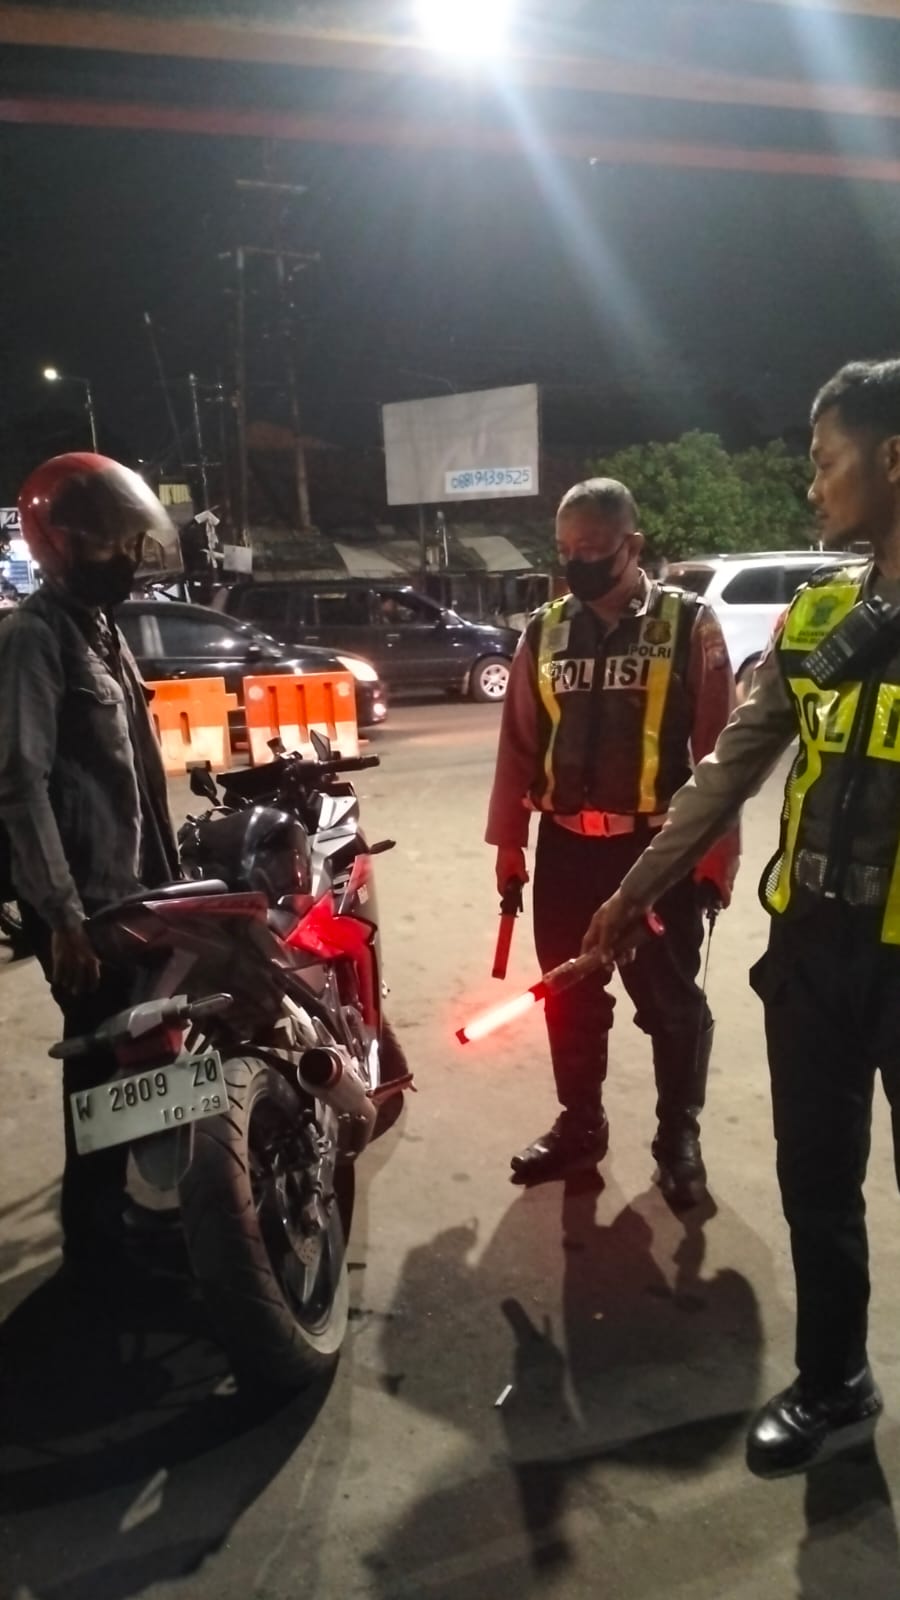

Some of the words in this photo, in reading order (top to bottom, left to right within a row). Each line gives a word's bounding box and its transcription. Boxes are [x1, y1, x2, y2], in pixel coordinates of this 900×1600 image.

[629, 644, 671, 658] POLRI
[75, 1094, 92, 1122] W
[109, 1072, 168, 1112] 2809
